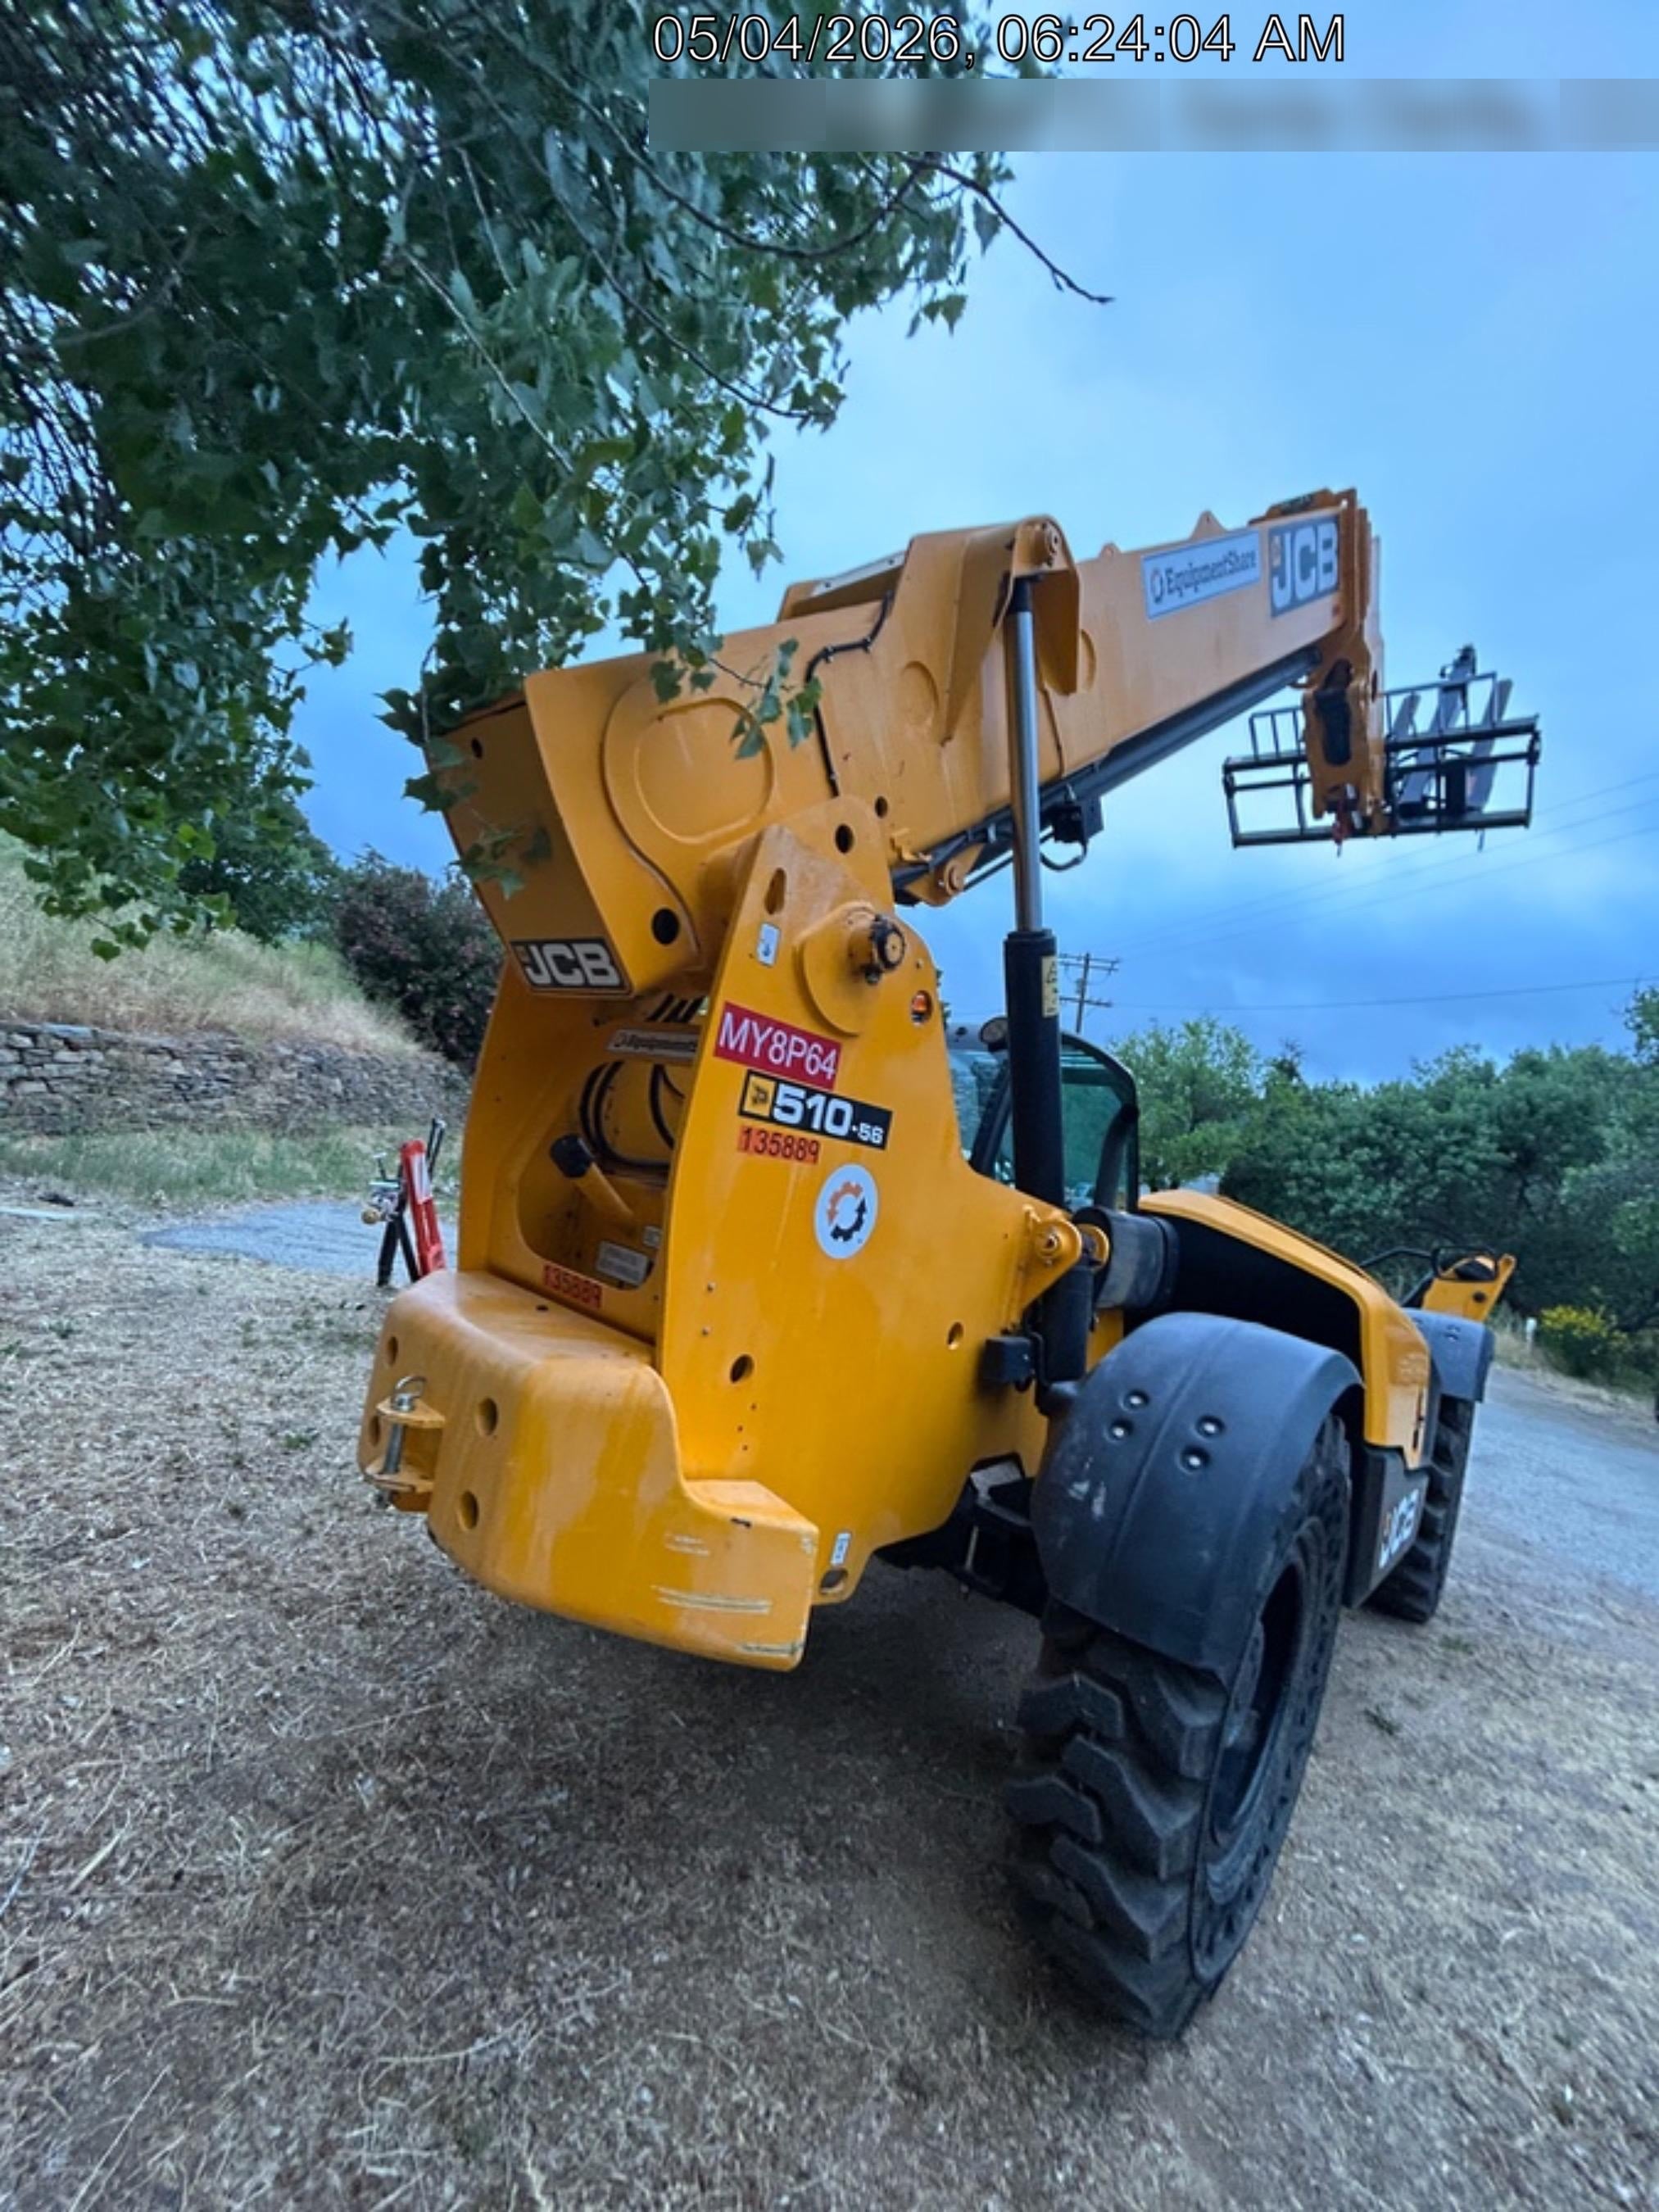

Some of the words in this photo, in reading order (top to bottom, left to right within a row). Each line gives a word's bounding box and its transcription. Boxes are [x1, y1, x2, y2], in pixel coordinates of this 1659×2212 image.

[1164, 550, 1257, 597] EquipmentShare
[1271, 522, 1339, 610] JCB
[515, 943, 620, 986] JCB
[719, 1012, 837, 1080] MY8P64
[741, 1126, 820, 1163] 135889
